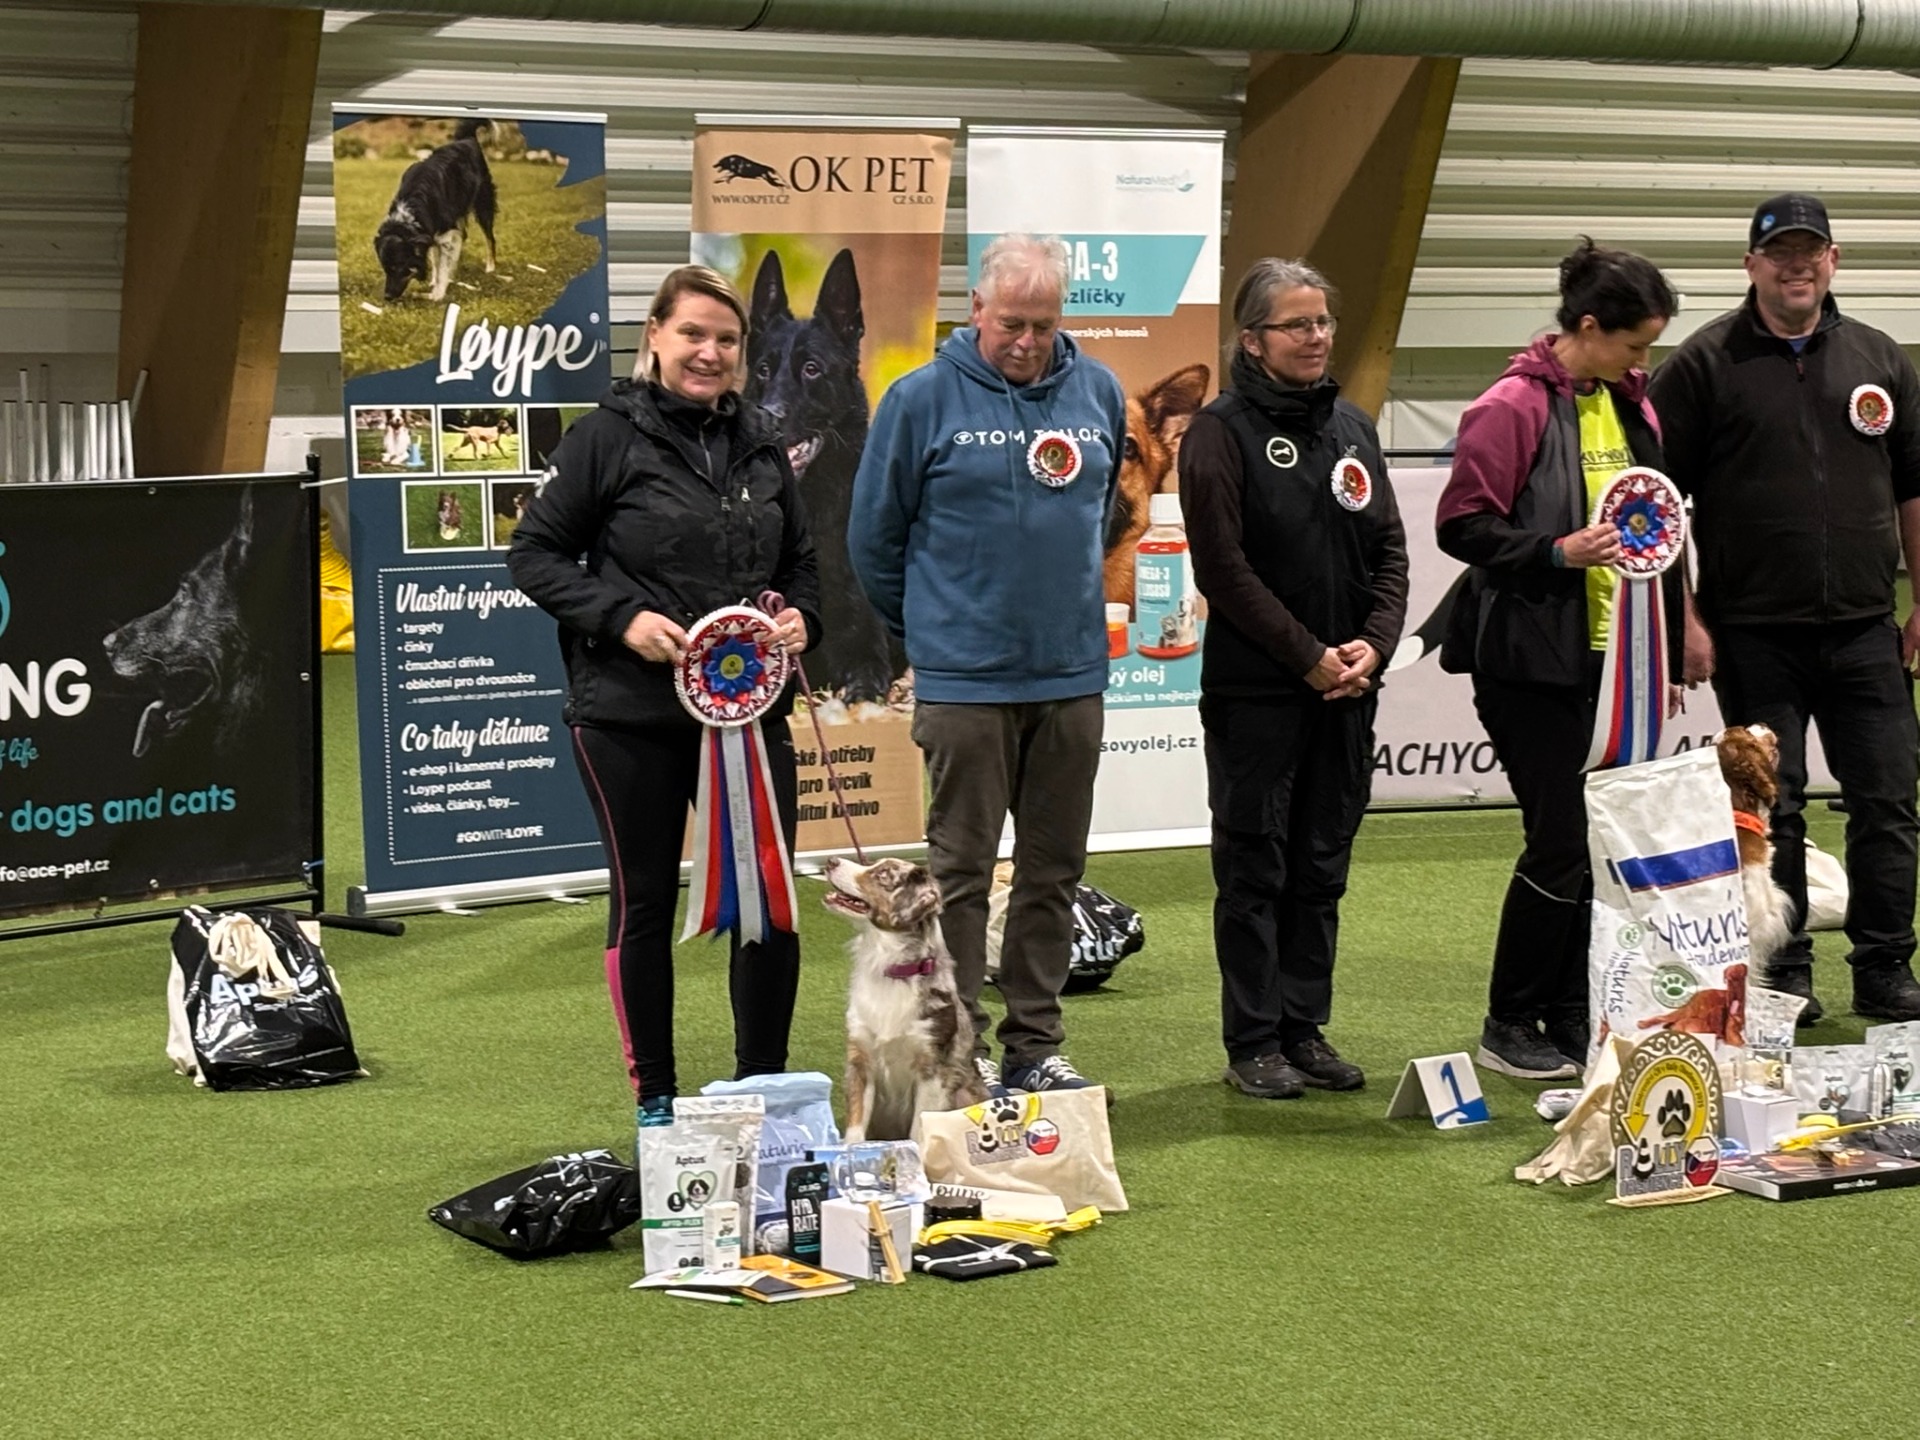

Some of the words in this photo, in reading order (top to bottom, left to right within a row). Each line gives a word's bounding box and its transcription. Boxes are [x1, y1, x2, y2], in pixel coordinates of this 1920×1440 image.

[789, 155, 853, 193] OK
[864, 156, 935, 193] PET
[711, 194, 790, 205] WWW.OKPET.CZ
[892, 194, 907, 205] CZ
[1064, 288, 1126, 308] zlíčky
[435, 302, 606, 398] Løype
[974, 429, 1026, 446] TOM
[395, 582, 467, 614] Vlastní
[0, 658, 92, 722] NG
[1131, 665, 1165, 686] olej
[400, 723, 431, 753] Co
[430, 720, 479, 758] taky
[478, 717, 551, 747] děláme:
[8, 738, 40, 769] life
[1372, 741, 1508, 776] ACHYO
[799, 778, 823, 797] pro
[11, 800, 95, 838] dogs
[102, 787, 164, 824] and
[169, 784, 237, 816] cats
